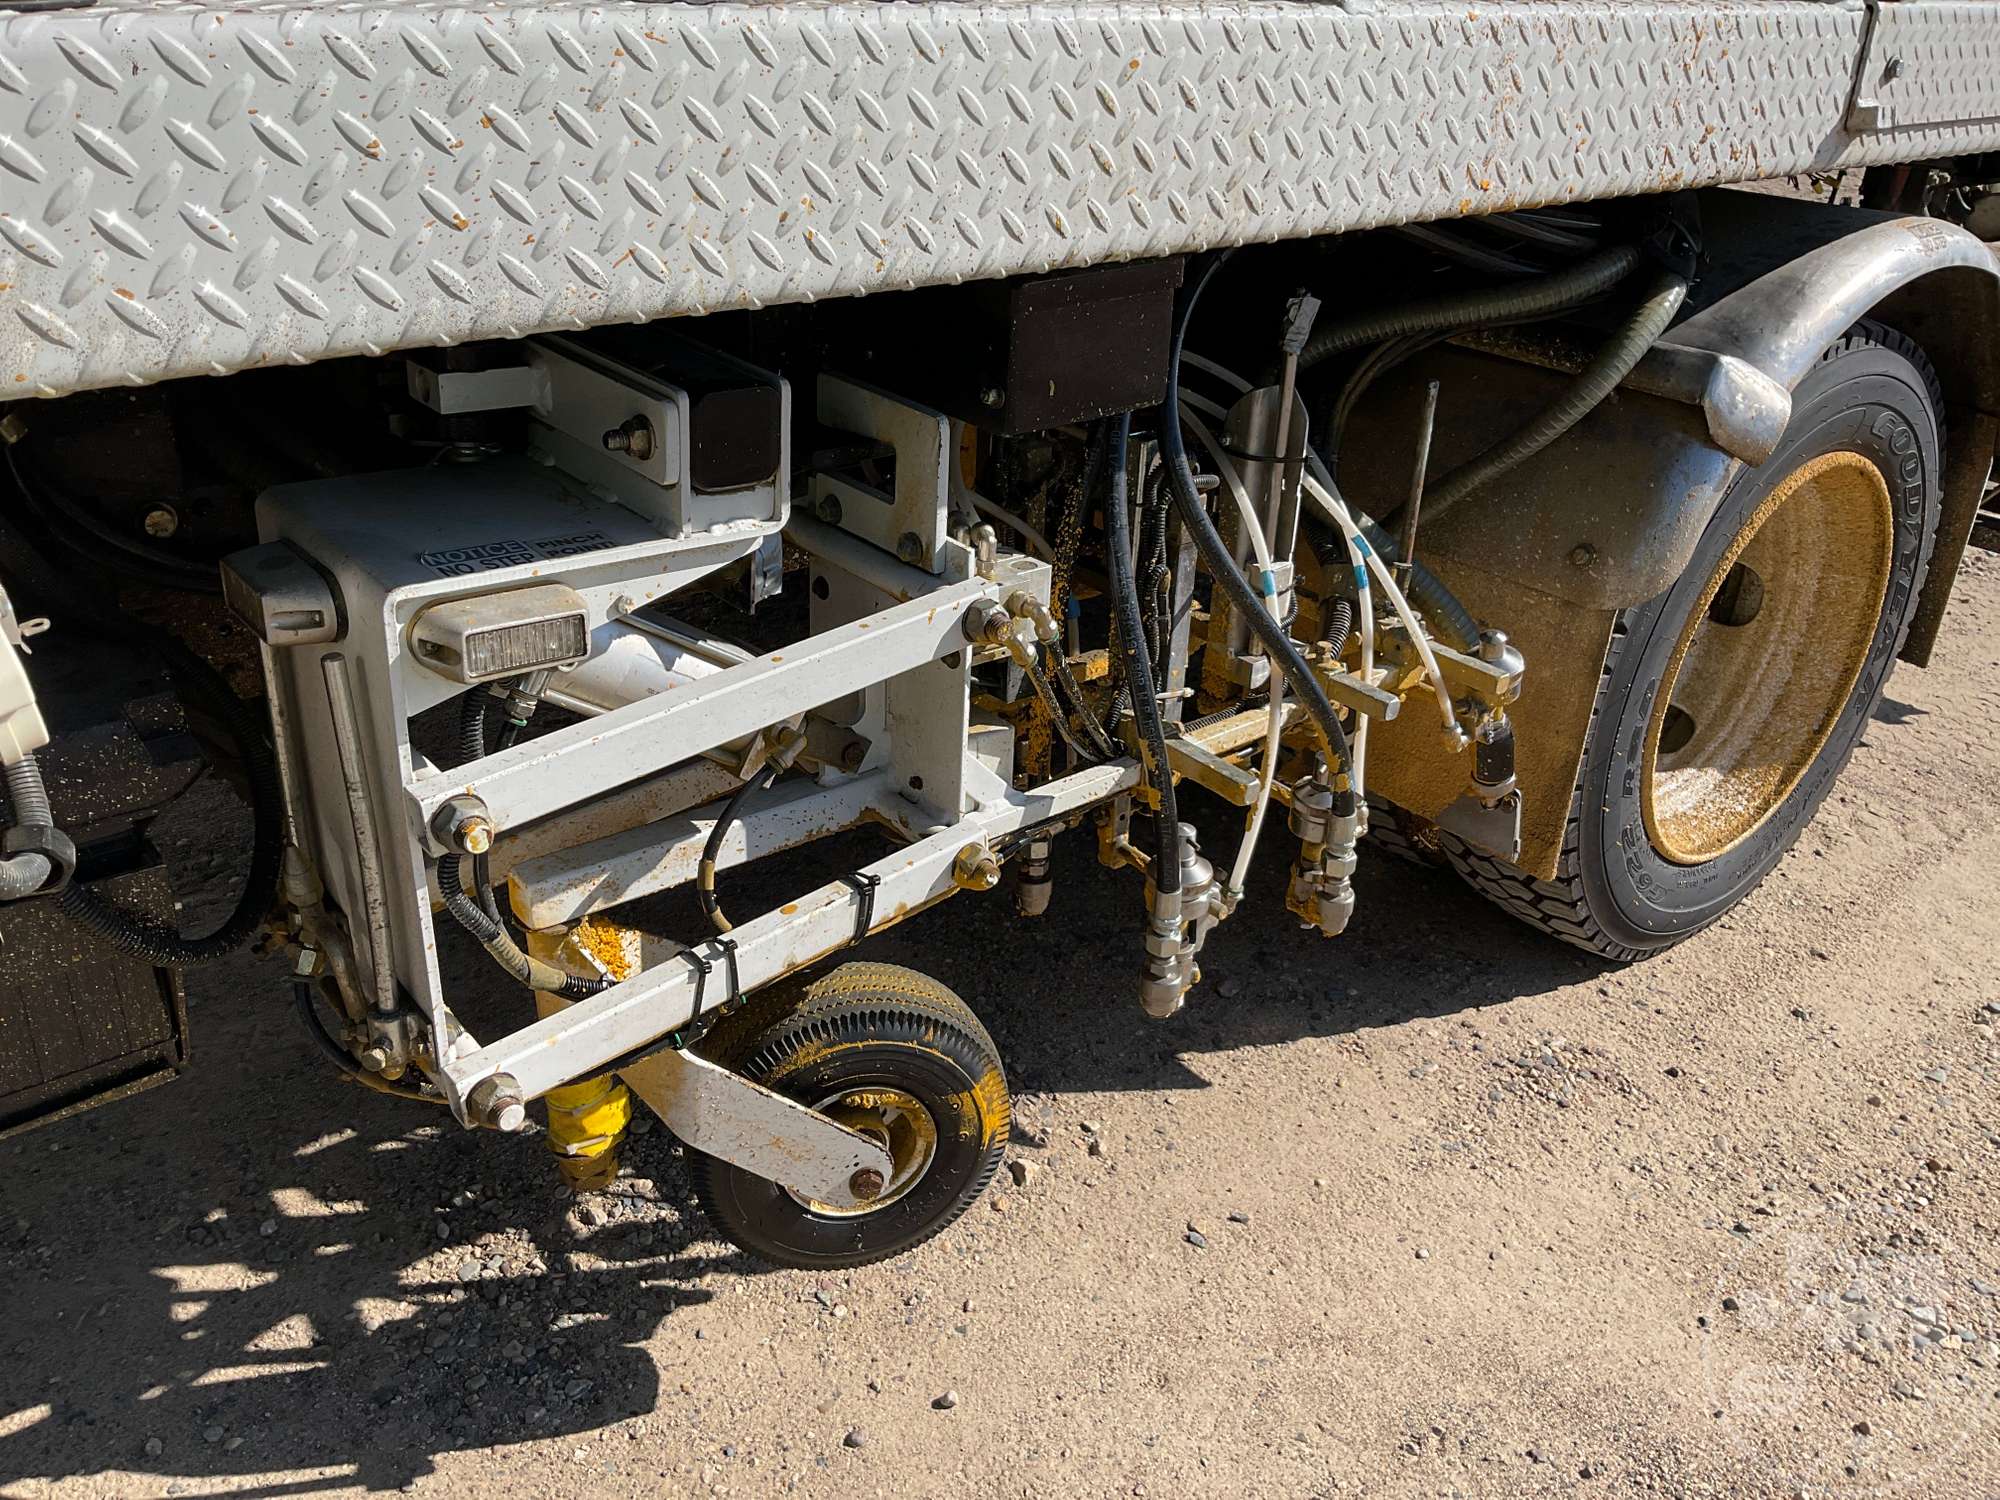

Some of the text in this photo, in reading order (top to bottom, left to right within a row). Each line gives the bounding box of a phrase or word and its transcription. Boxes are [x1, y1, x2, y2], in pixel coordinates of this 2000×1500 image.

[425, 540, 520, 565] NOTICE
[536, 533, 605, 549] PINCH
[437, 552, 535, 577] NO STEP
[1853, 409, 1924, 717] GOODYEAR
